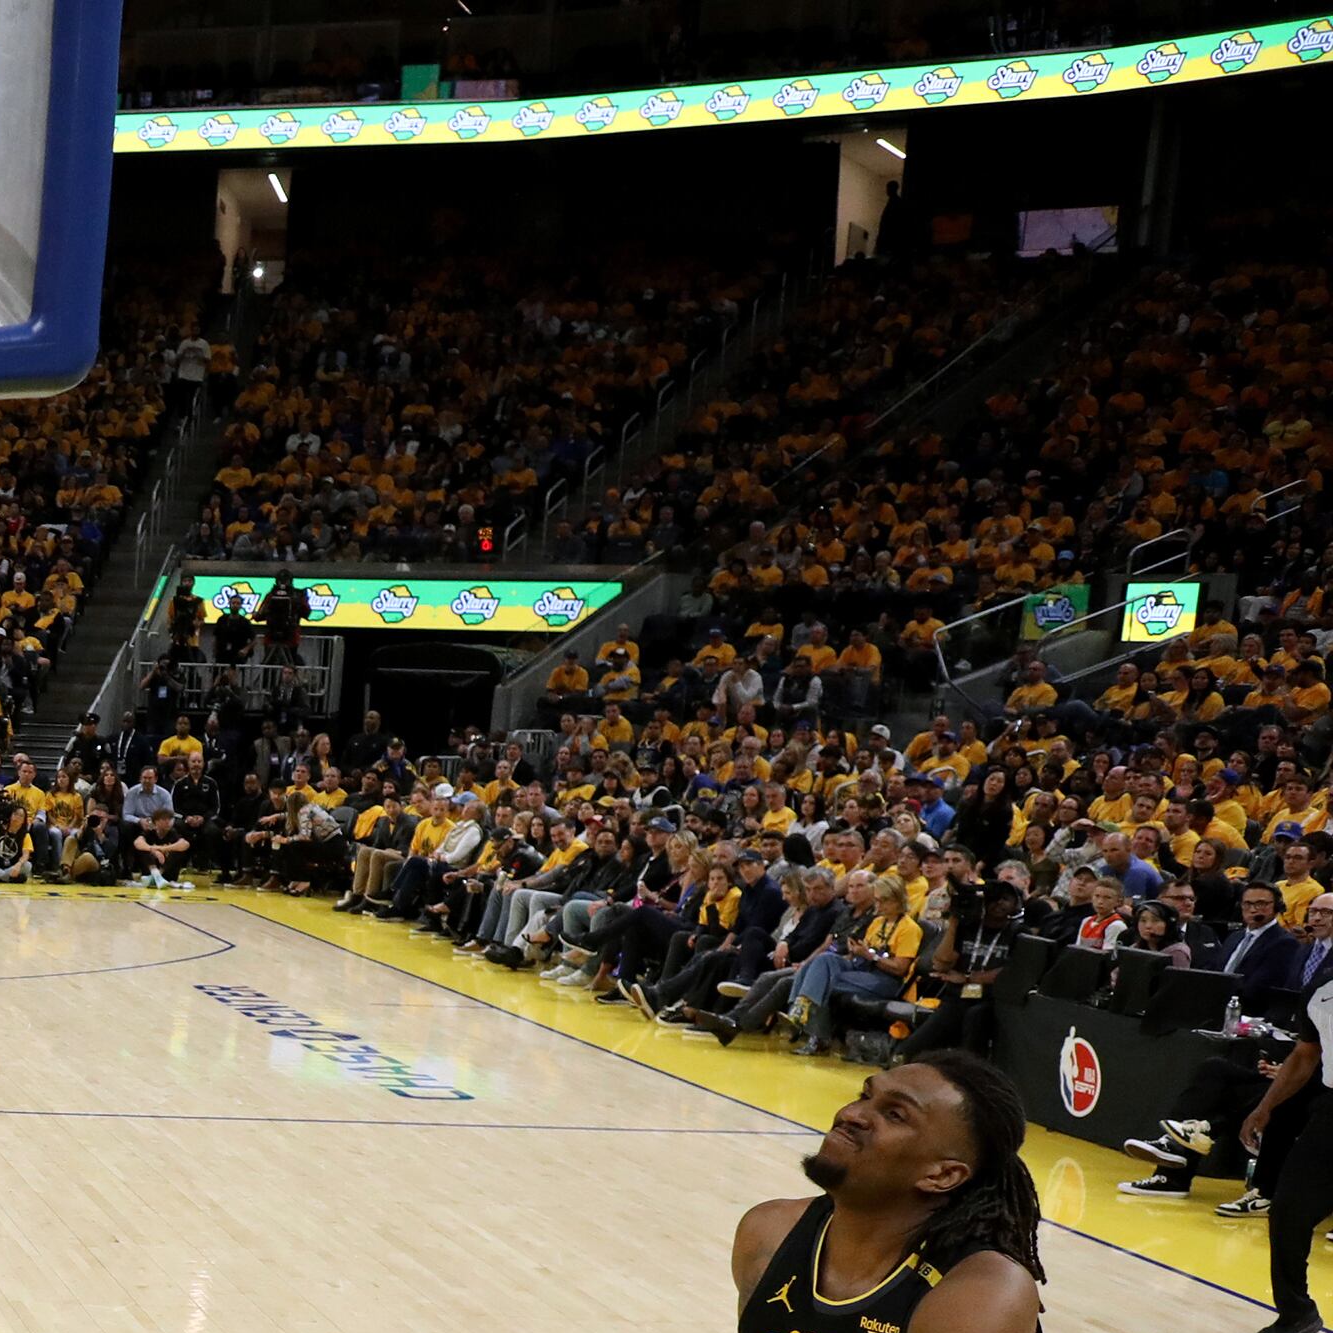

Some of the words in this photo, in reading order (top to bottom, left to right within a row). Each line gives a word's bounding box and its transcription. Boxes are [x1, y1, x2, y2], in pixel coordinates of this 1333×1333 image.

[1137, 45, 1187, 80] Starry
[1210, 34, 1263, 69] Starry
[913, 69, 963, 100] Starry
[987, 62, 1039, 95] Starry
[1063, 56, 1114, 90] Starry
[705, 87, 751, 117] Starry
[773, 80, 820, 111] Starry
[842, 75, 891, 105] Starry
[575, 99, 619, 127] Starry
[639, 94, 685, 122] Starry
[306, 587, 341, 616] tarry
[371, 588, 418, 618] Starry
[449, 590, 500, 620] Starry
[533, 591, 584, 621] Starry
[1136, 595, 1184, 628] Starry
